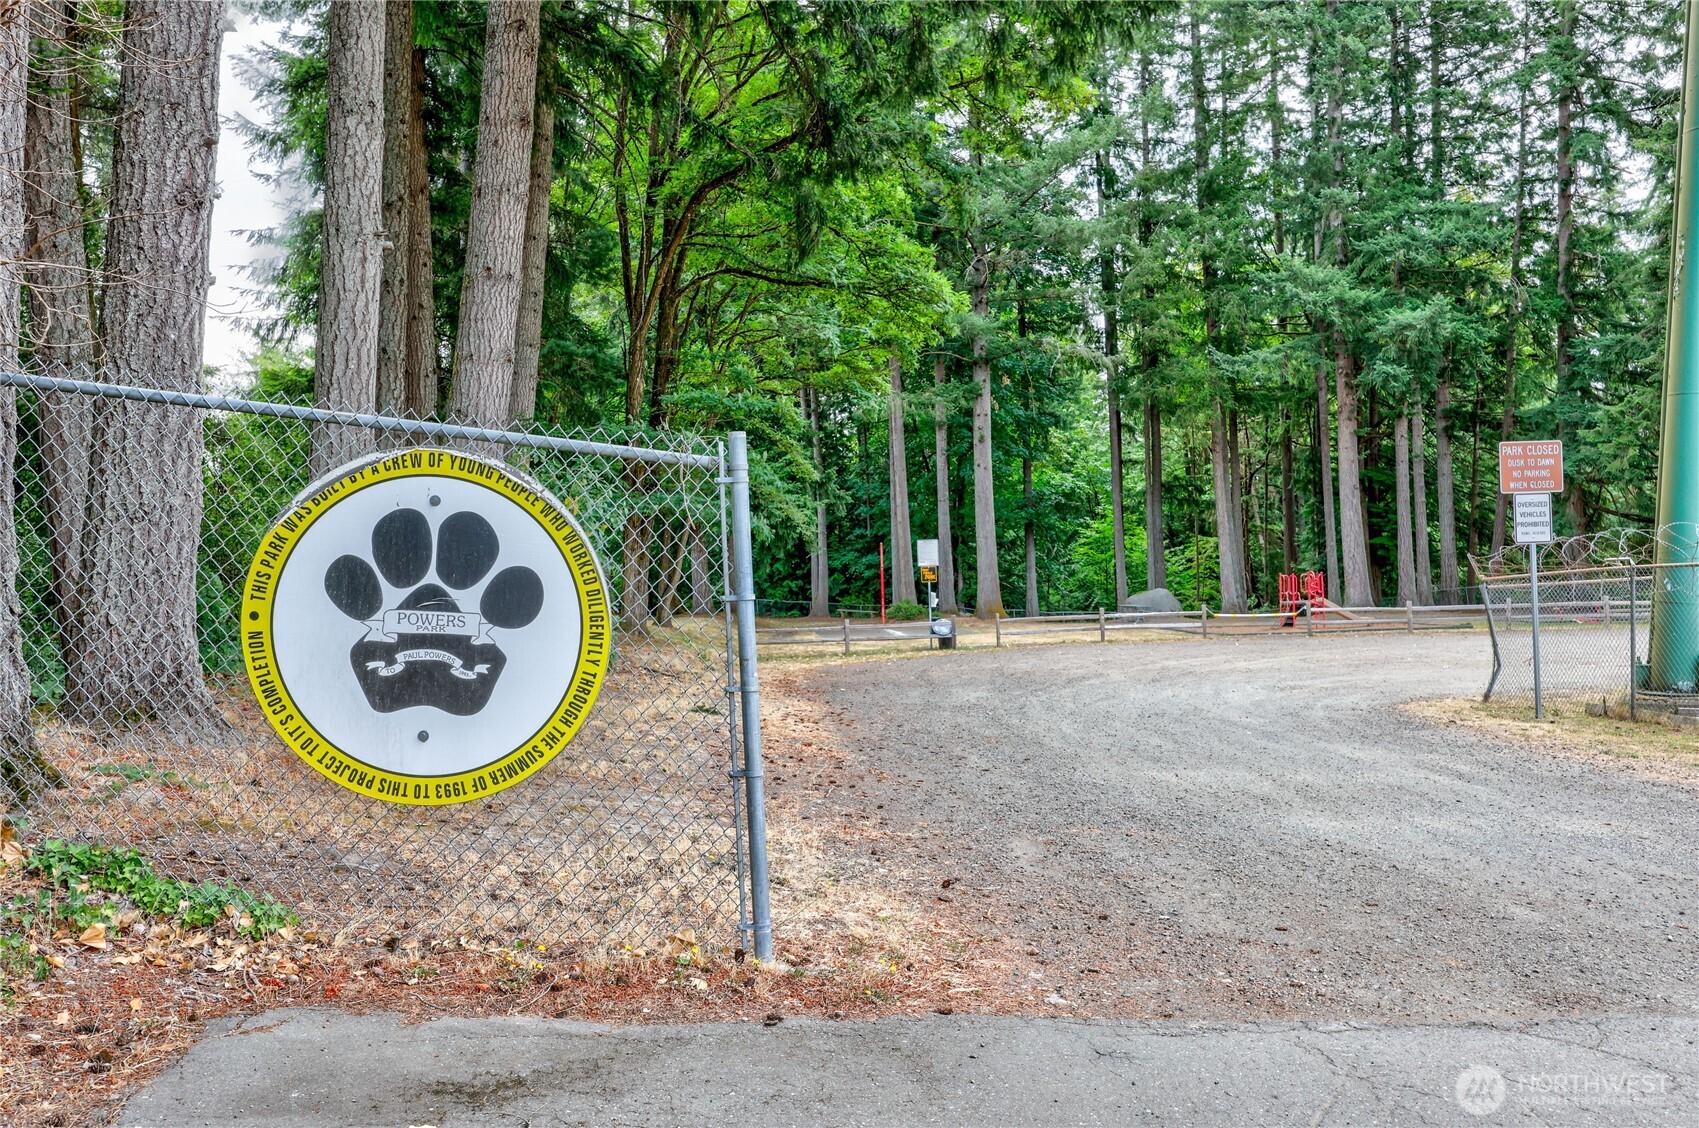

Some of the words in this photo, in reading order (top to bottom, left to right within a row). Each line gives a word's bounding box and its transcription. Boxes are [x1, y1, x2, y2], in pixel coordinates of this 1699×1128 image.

[428, 452, 444, 468] OF
[1502, 446, 1523, 456] PARK
[1526, 444, 1559, 455] CLOSED
[370, 465, 380, 476] A
[383, 453, 422, 472] CREW
[450, 453, 495, 480] YOUNG
[1507, 458, 1525, 467] DUSK
[1527, 458, 1535, 467] TO
[1537, 457, 1555, 466] DAWN
[1512, 470, 1522, 478] NO
[1524, 469, 1551, 478] PARKING
[496, 473, 541, 507] PEOPLE
[1509, 481, 1528, 489] WHEN
[1530, 480, 1555, 489] CLOSED
[281, 503, 313, 533] WAS
[539, 501, 569, 532] WHO
[259, 531, 289, 569] PARK
[562, 527, 598, 586] WORKED
[250, 570, 272, 601] THIS
[397, 612, 466, 628] POWERS
[416, 624, 447, 633] PARK
[585, 588, 605, 667] DILIGENTLY
[403, 651, 424, 661] PAUL
[424, 651, 457, 665] POWERS
[248, 631, 287, 715] COMPLETION
[559, 671, 597, 728] THROUGH
[279, 713, 306, 742] IT'S
[299, 737, 320, 757] TO
[540, 726, 566, 751] THE
[317, 751, 376, 790] PROJECT
[488, 745, 544, 785] SUMMER
[377, 778, 408, 798] THIS
[413, 783, 430, 800] TO
[435, 781, 468, 799] 1993
[471, 775, 488, 793] OF
